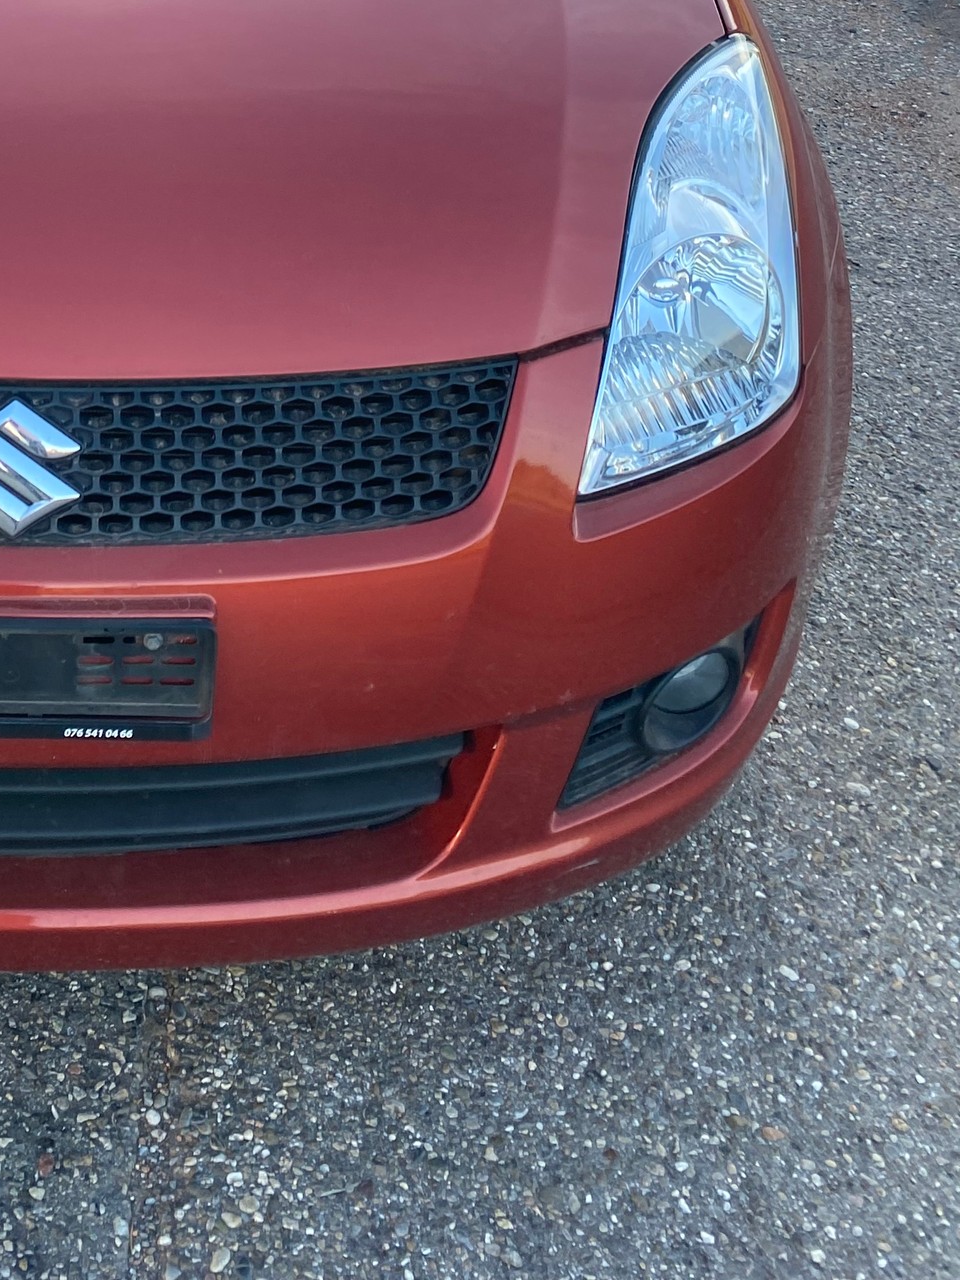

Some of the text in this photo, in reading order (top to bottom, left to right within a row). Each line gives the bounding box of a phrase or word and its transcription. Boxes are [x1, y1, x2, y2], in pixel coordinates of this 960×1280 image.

[64, 728, 133, 738] 076 541 04 66
